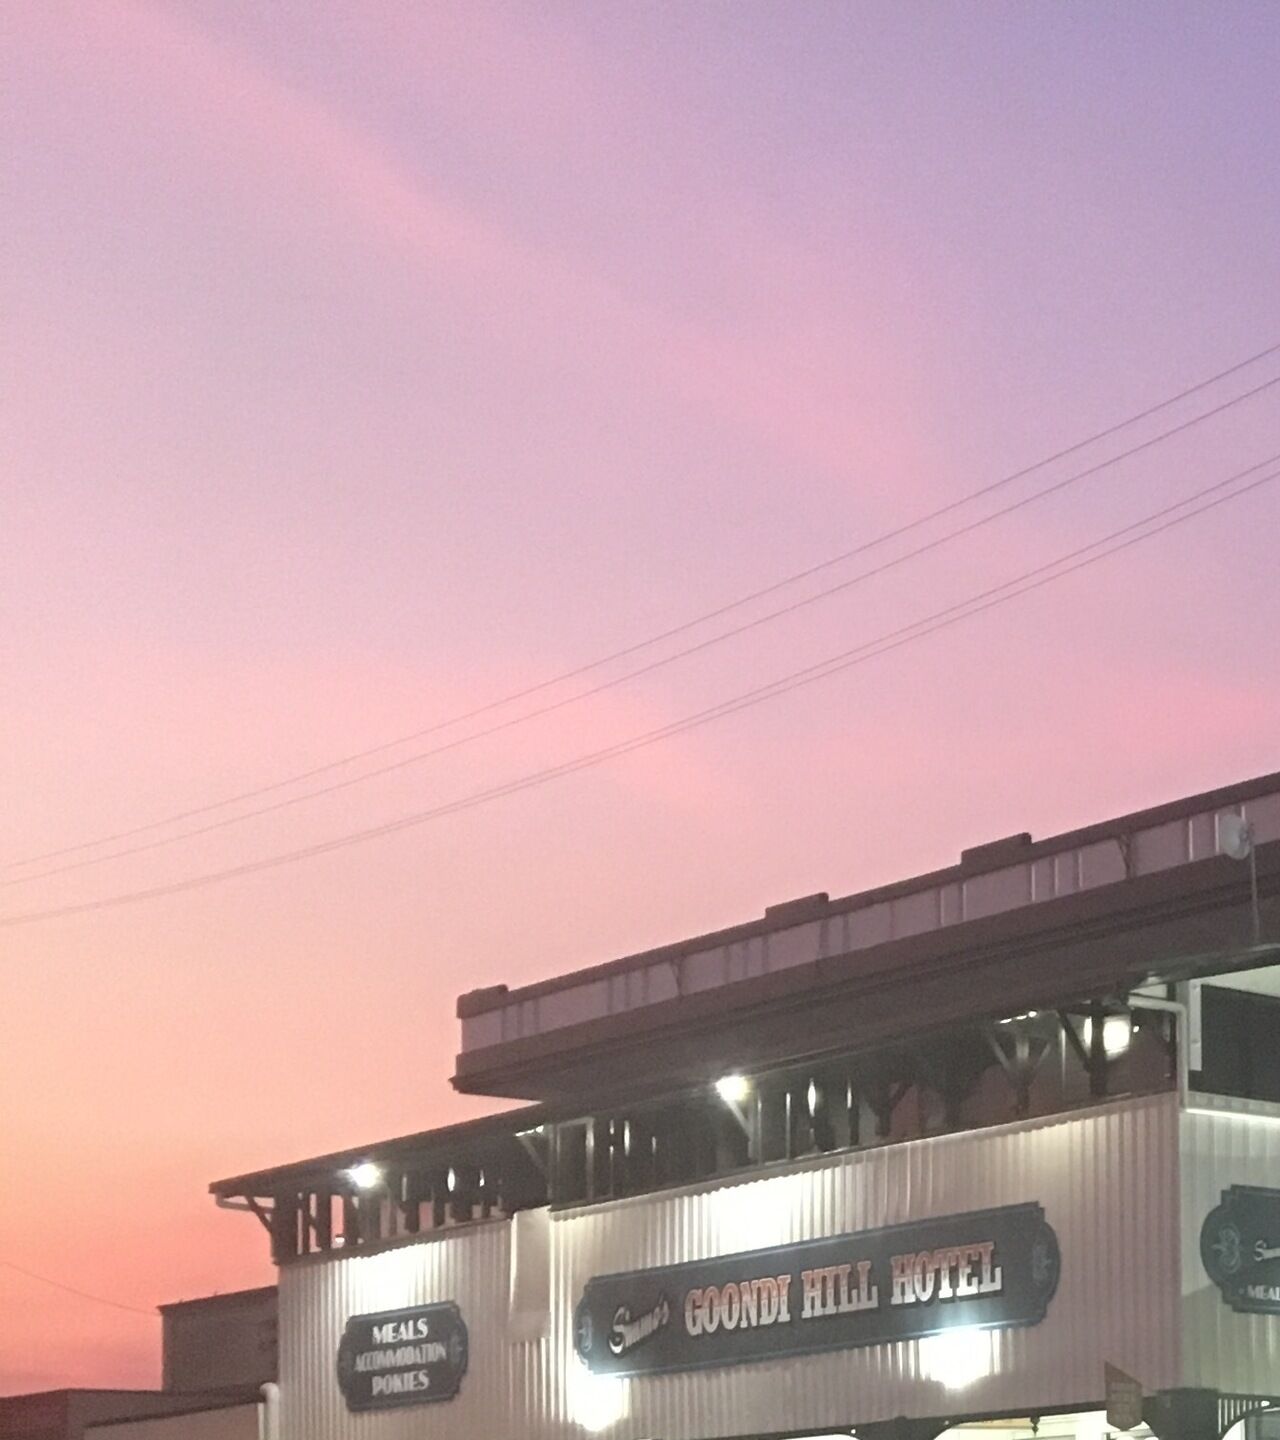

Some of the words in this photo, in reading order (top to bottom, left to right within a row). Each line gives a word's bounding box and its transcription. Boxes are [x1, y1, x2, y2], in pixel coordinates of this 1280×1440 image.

[684, 1273, 792, 1337] GOONDI
[800, 1260, 879, 1320] HILL
[890, 1241, 1003, 1305] HOTEL
[371, 1318, 429, 1344] MEALS
[371, 1370, 430, 1396] POKIES
